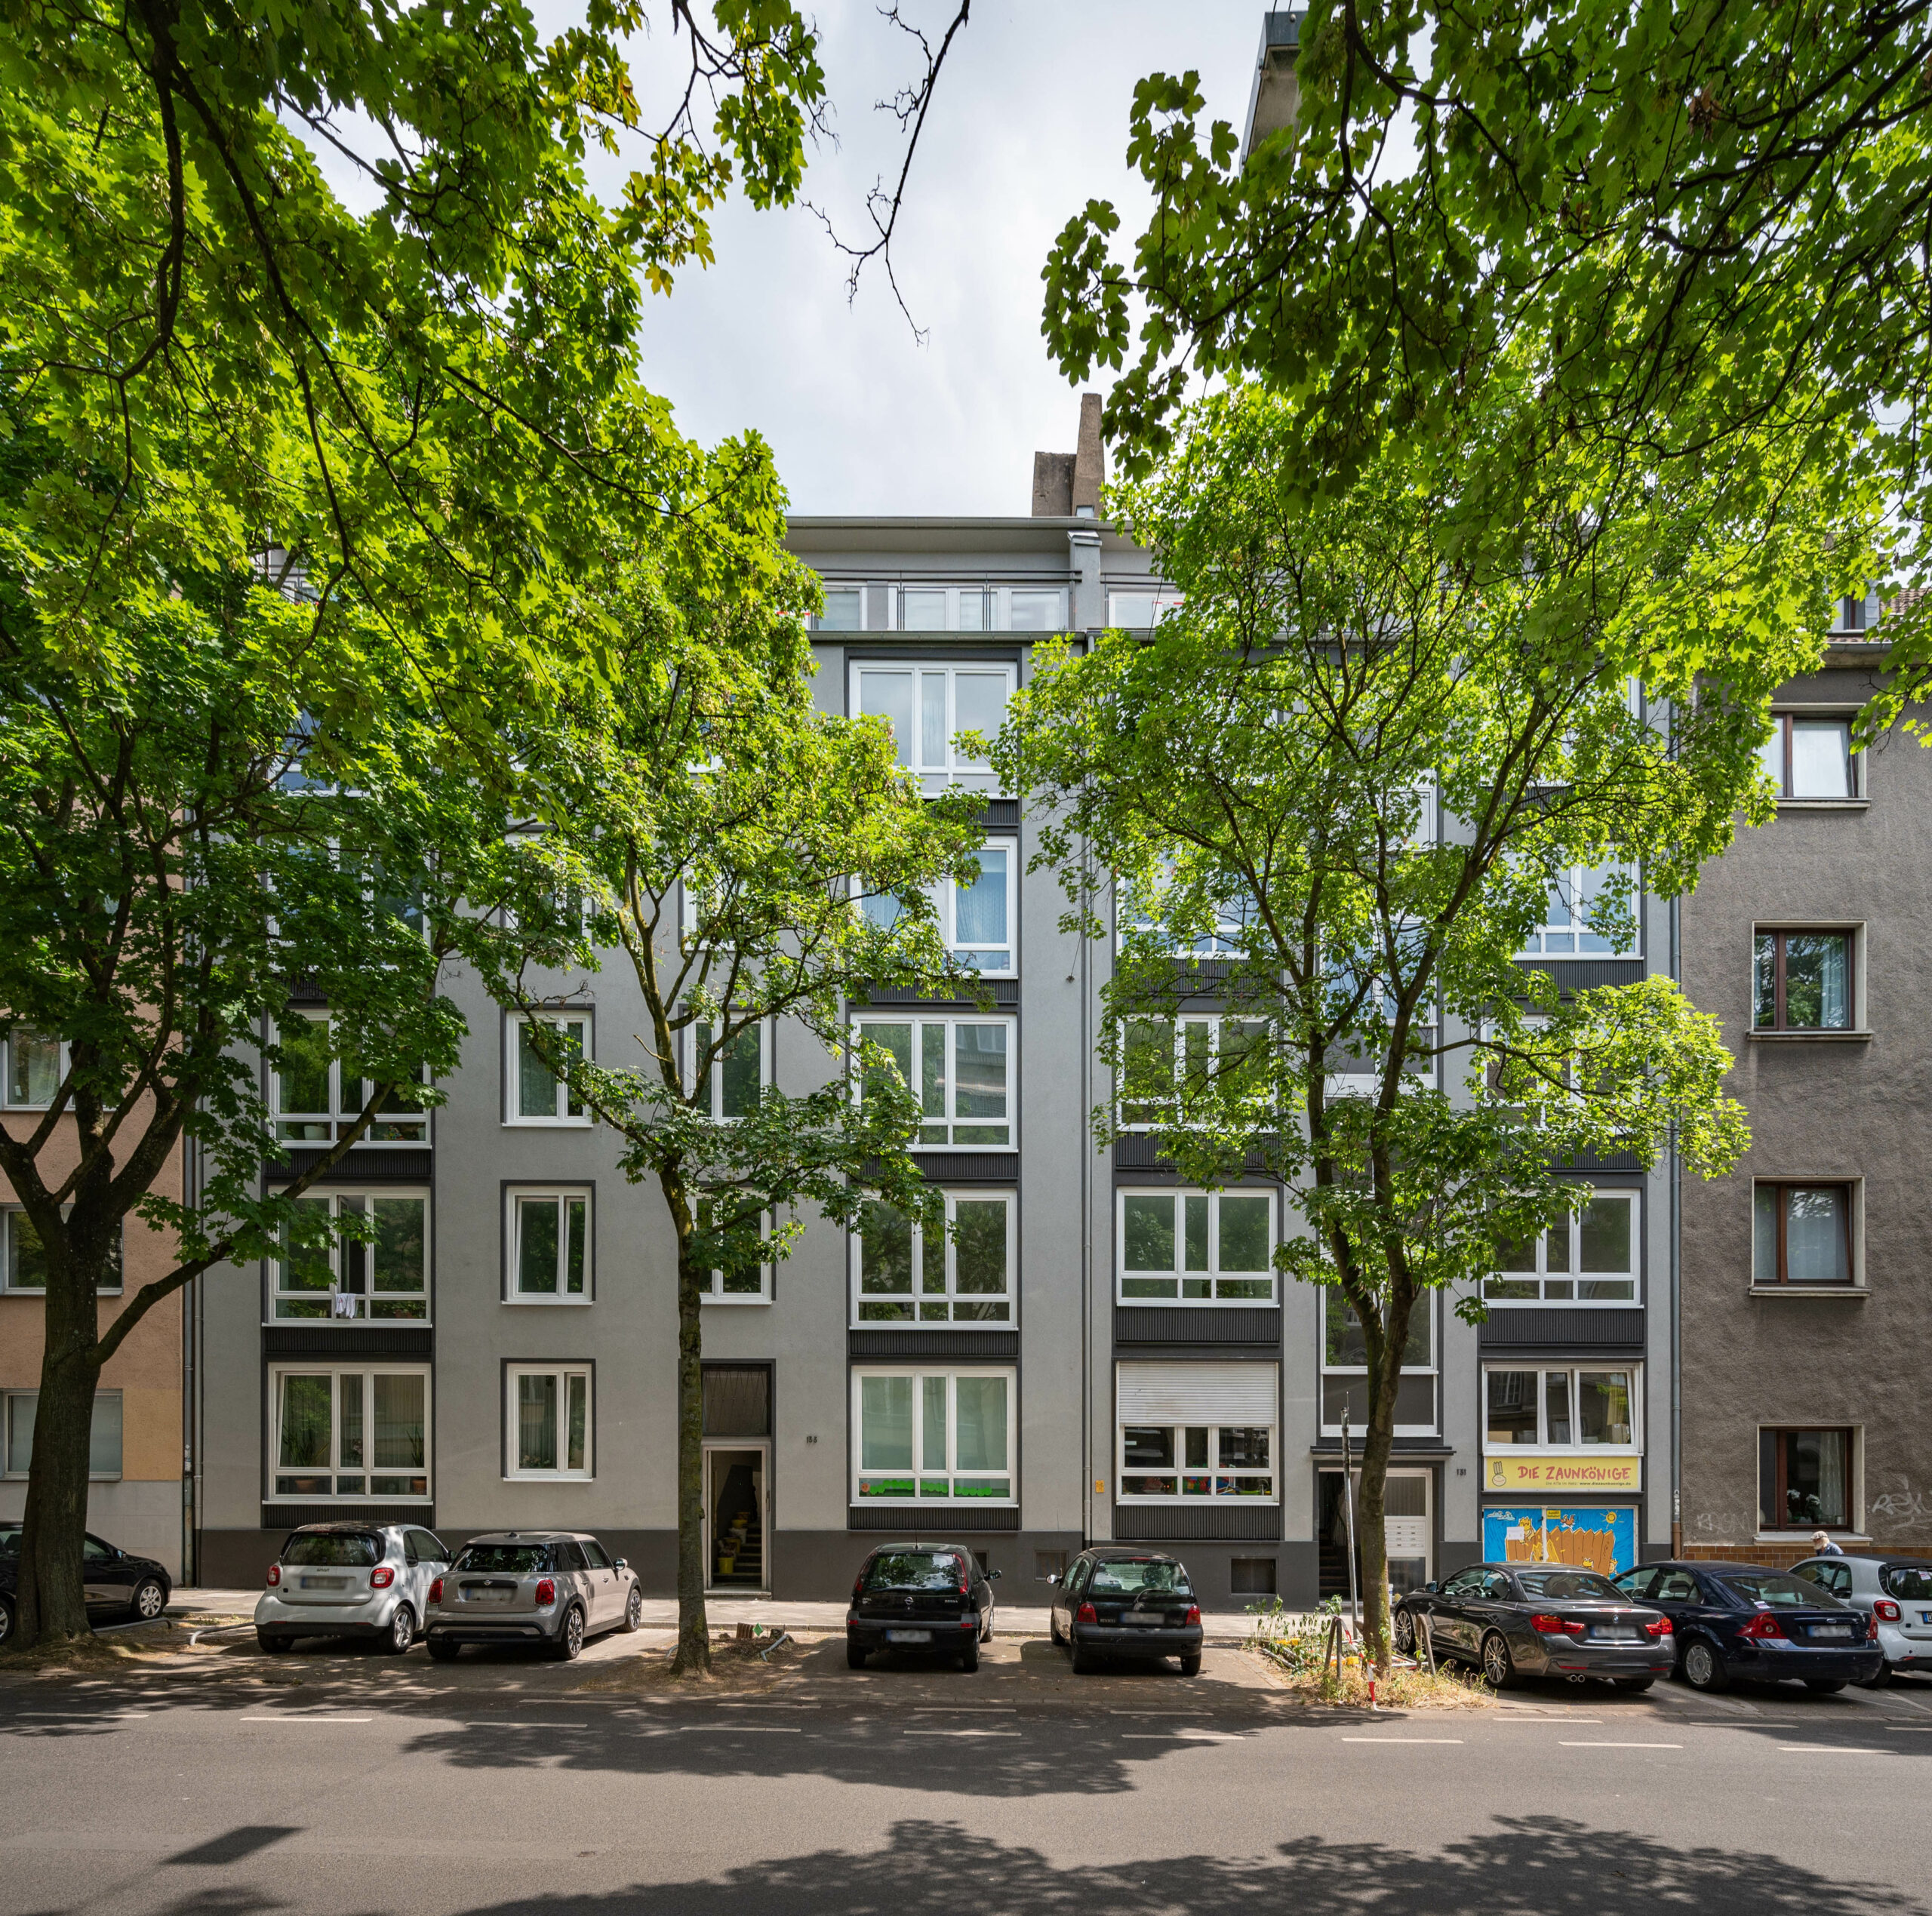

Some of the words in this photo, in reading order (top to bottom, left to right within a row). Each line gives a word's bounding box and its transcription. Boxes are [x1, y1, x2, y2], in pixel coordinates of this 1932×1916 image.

[806, 1435, 817, 1444] 133
[1517, 1465, 1540, 1479] DIE
[1546, 1466, 1632, 1481] ZAUNKÖNIGE
